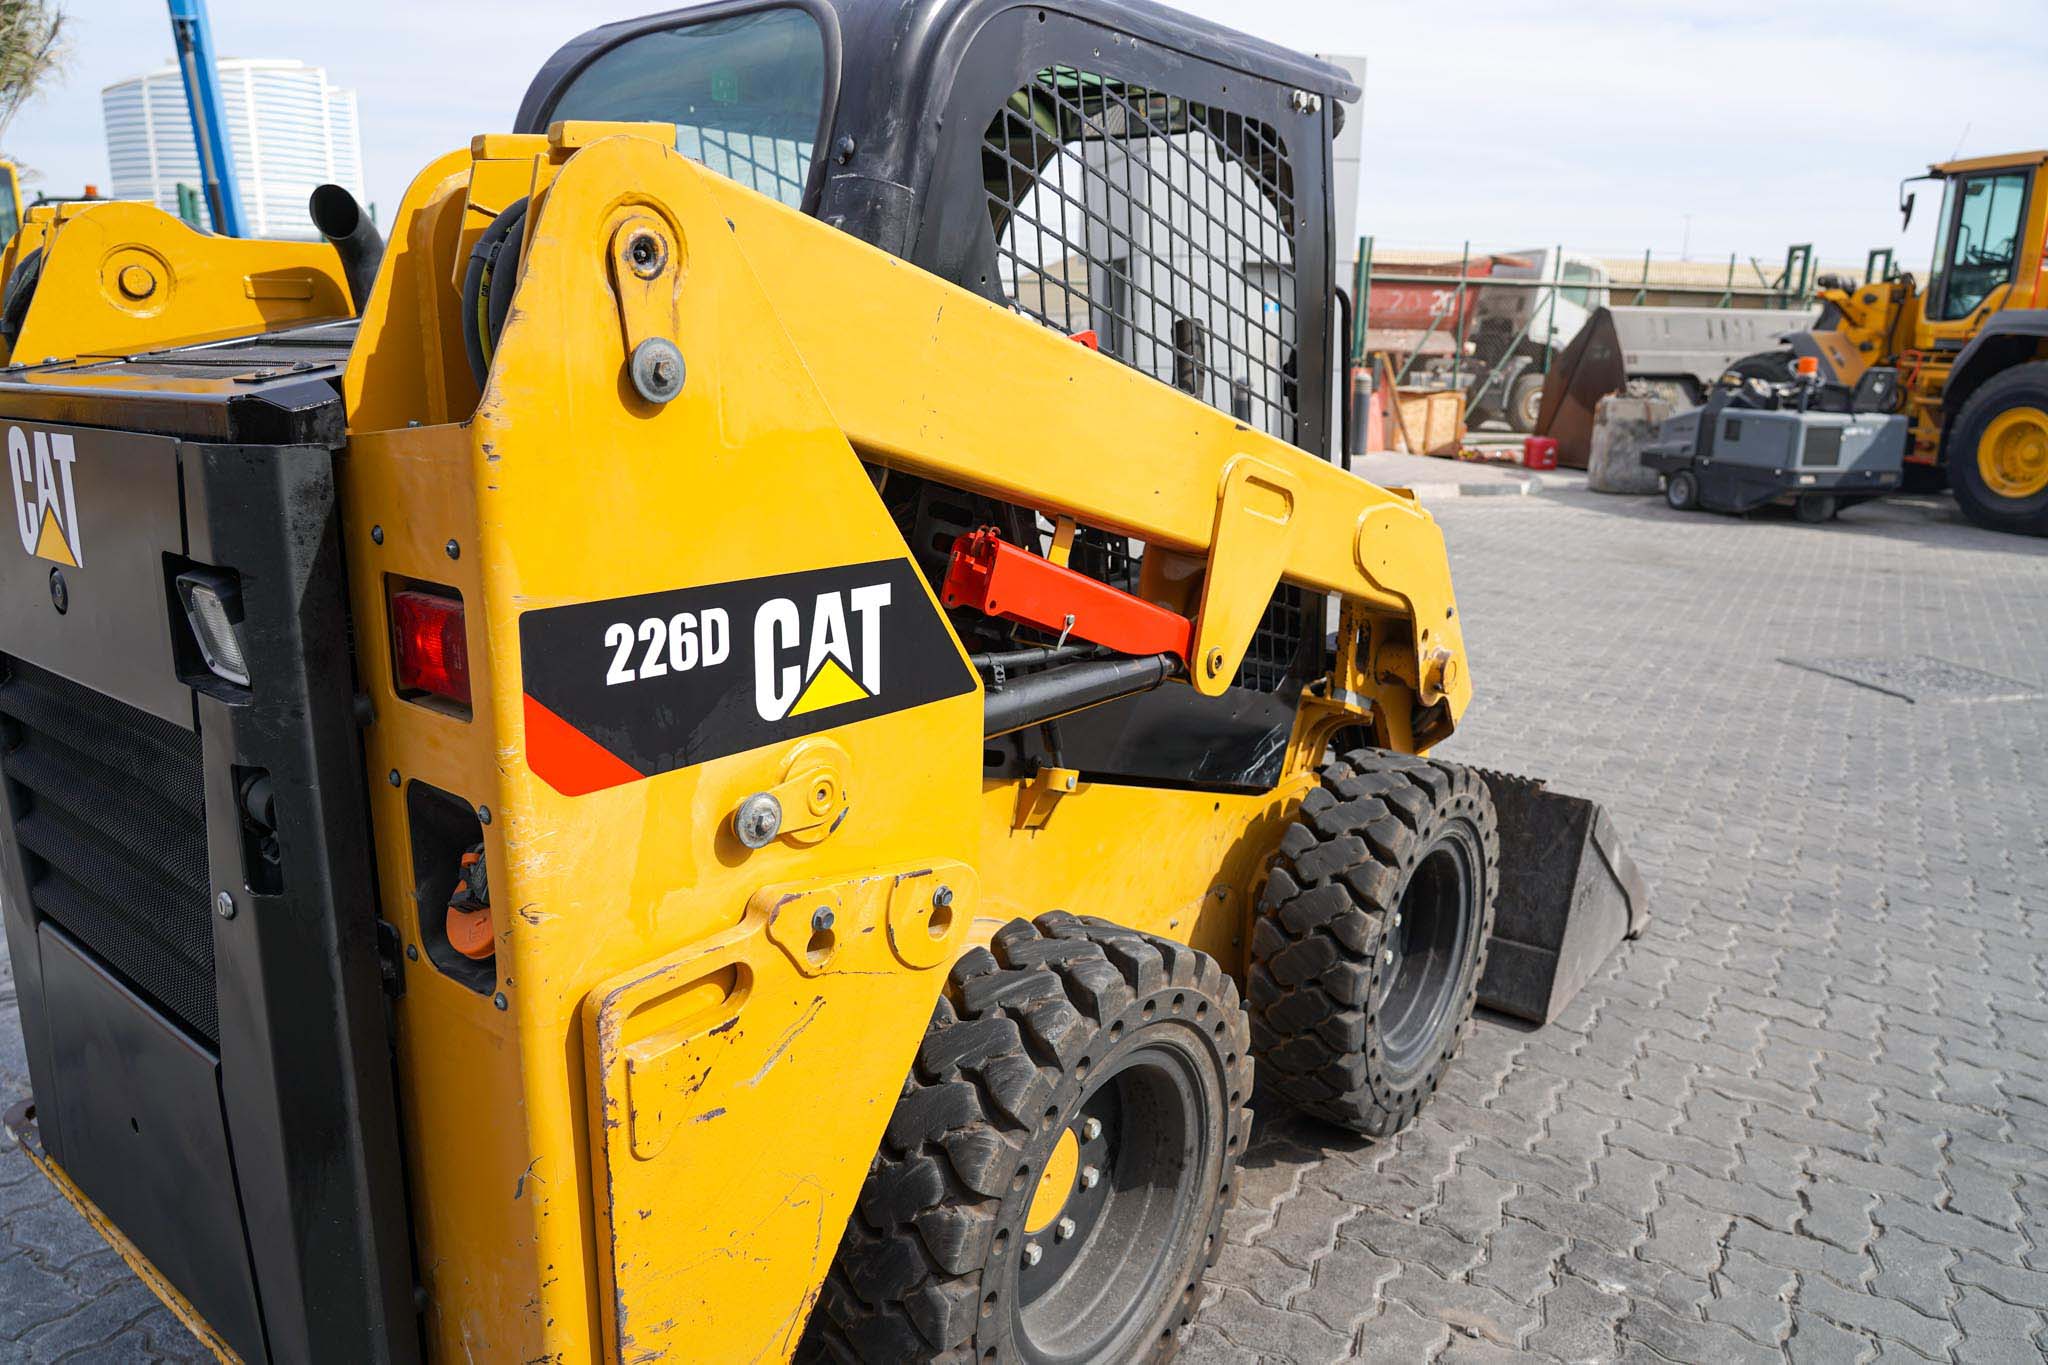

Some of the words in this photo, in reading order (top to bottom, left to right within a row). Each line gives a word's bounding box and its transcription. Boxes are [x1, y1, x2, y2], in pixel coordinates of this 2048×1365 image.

[8, 425, 83, 568] CAT
[604, 607, 730, 686] 226D
[753, 582, 892, 722] CAT
